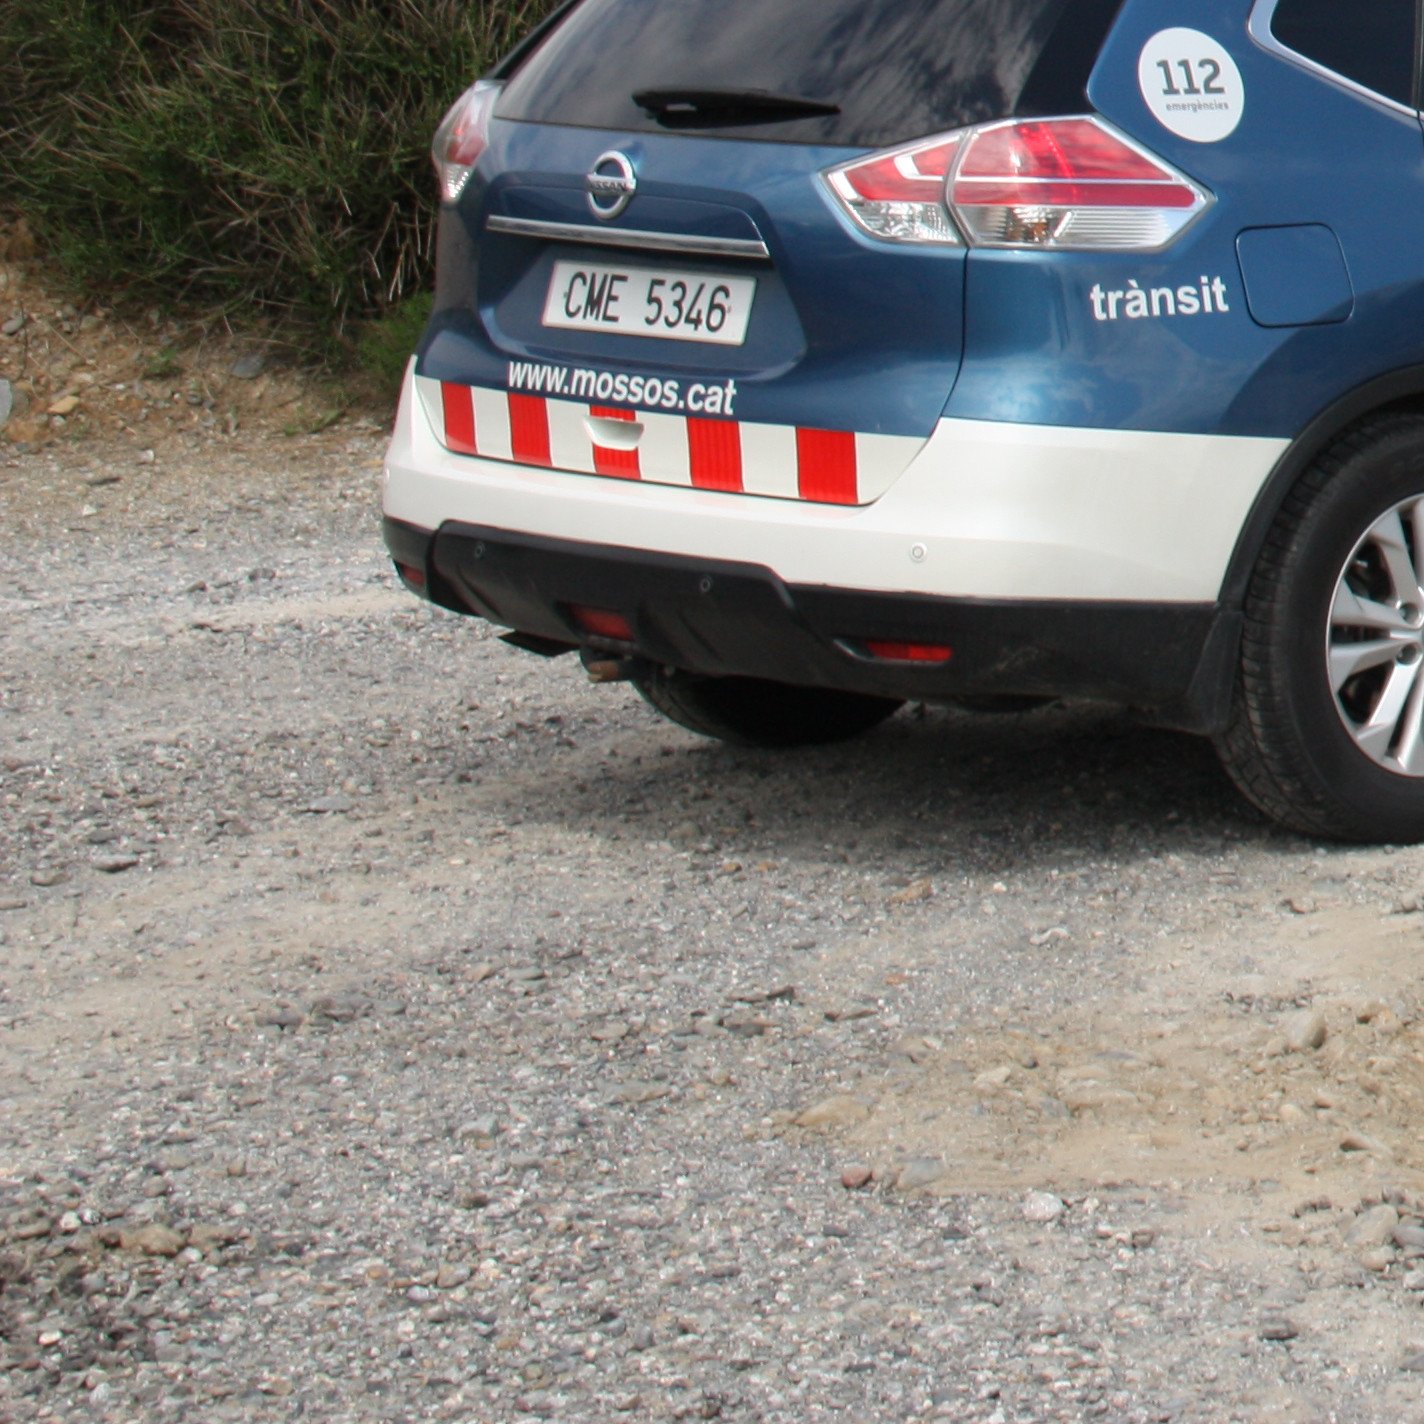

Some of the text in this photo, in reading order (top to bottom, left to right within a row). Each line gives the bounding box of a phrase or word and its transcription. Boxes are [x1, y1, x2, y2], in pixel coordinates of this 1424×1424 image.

[1156, 58, 1225, 95] 112
[1165, 98, 1229, 113] emergències
[565, 271, 730, 333] CME 5346
[1090, 276, 1230, 321] trànsit
[508, 360, 737, 416] www.mossos.cat
